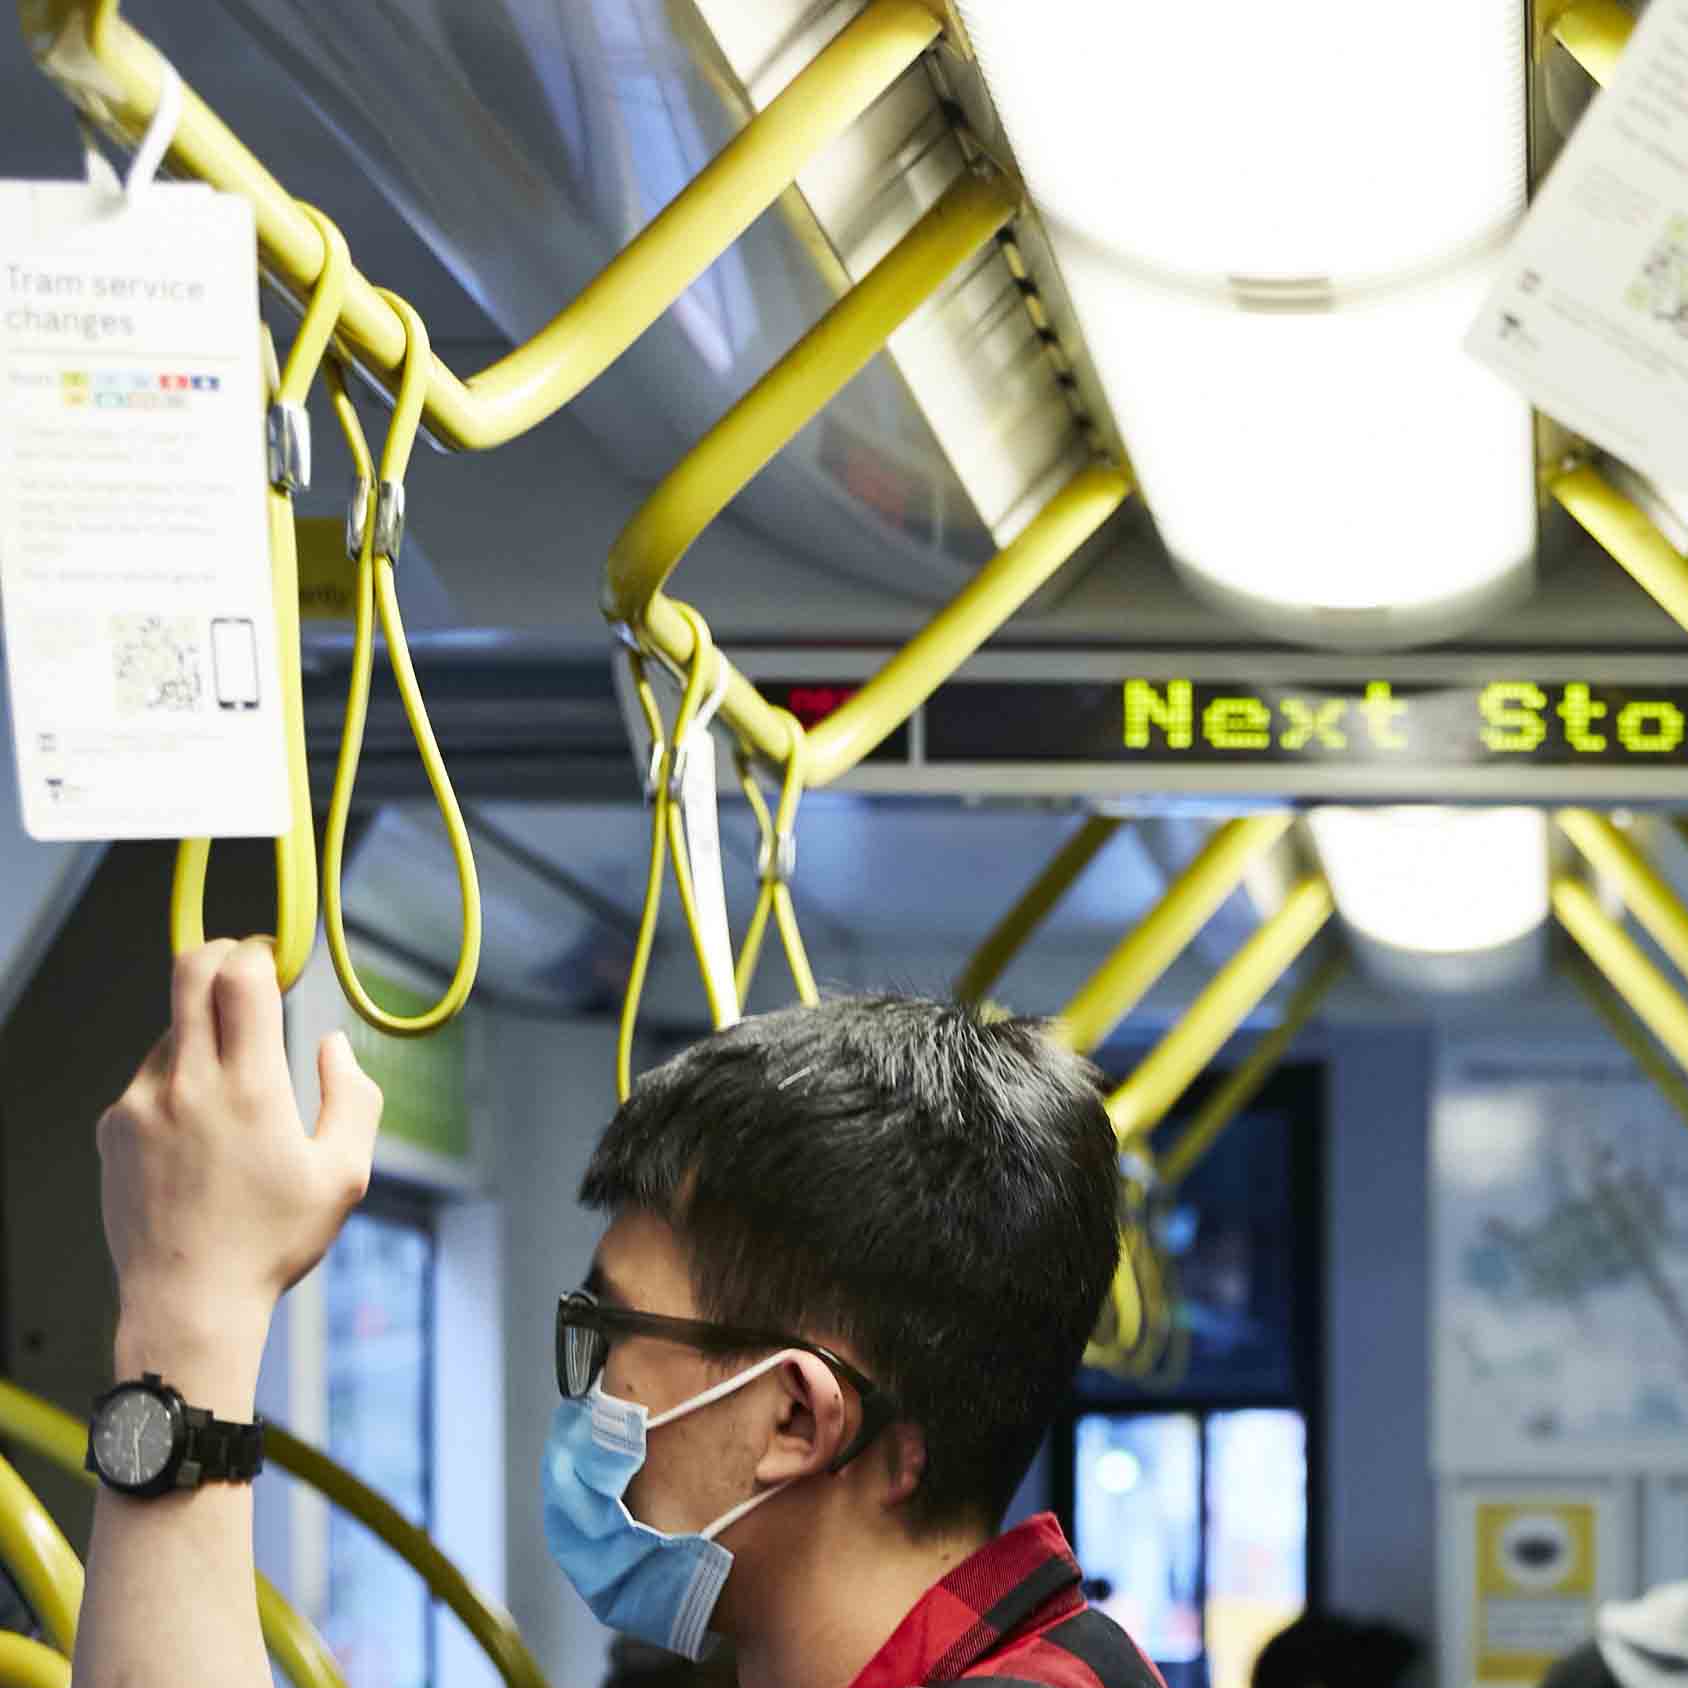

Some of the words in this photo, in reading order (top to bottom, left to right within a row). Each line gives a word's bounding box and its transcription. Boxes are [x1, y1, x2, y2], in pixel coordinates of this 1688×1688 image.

[6, 264, 83, 297] Tram
[93, 273, 206, 302] service
[5, 303, 136, 341] changes
[1123, 679, 1409, 749] Next
